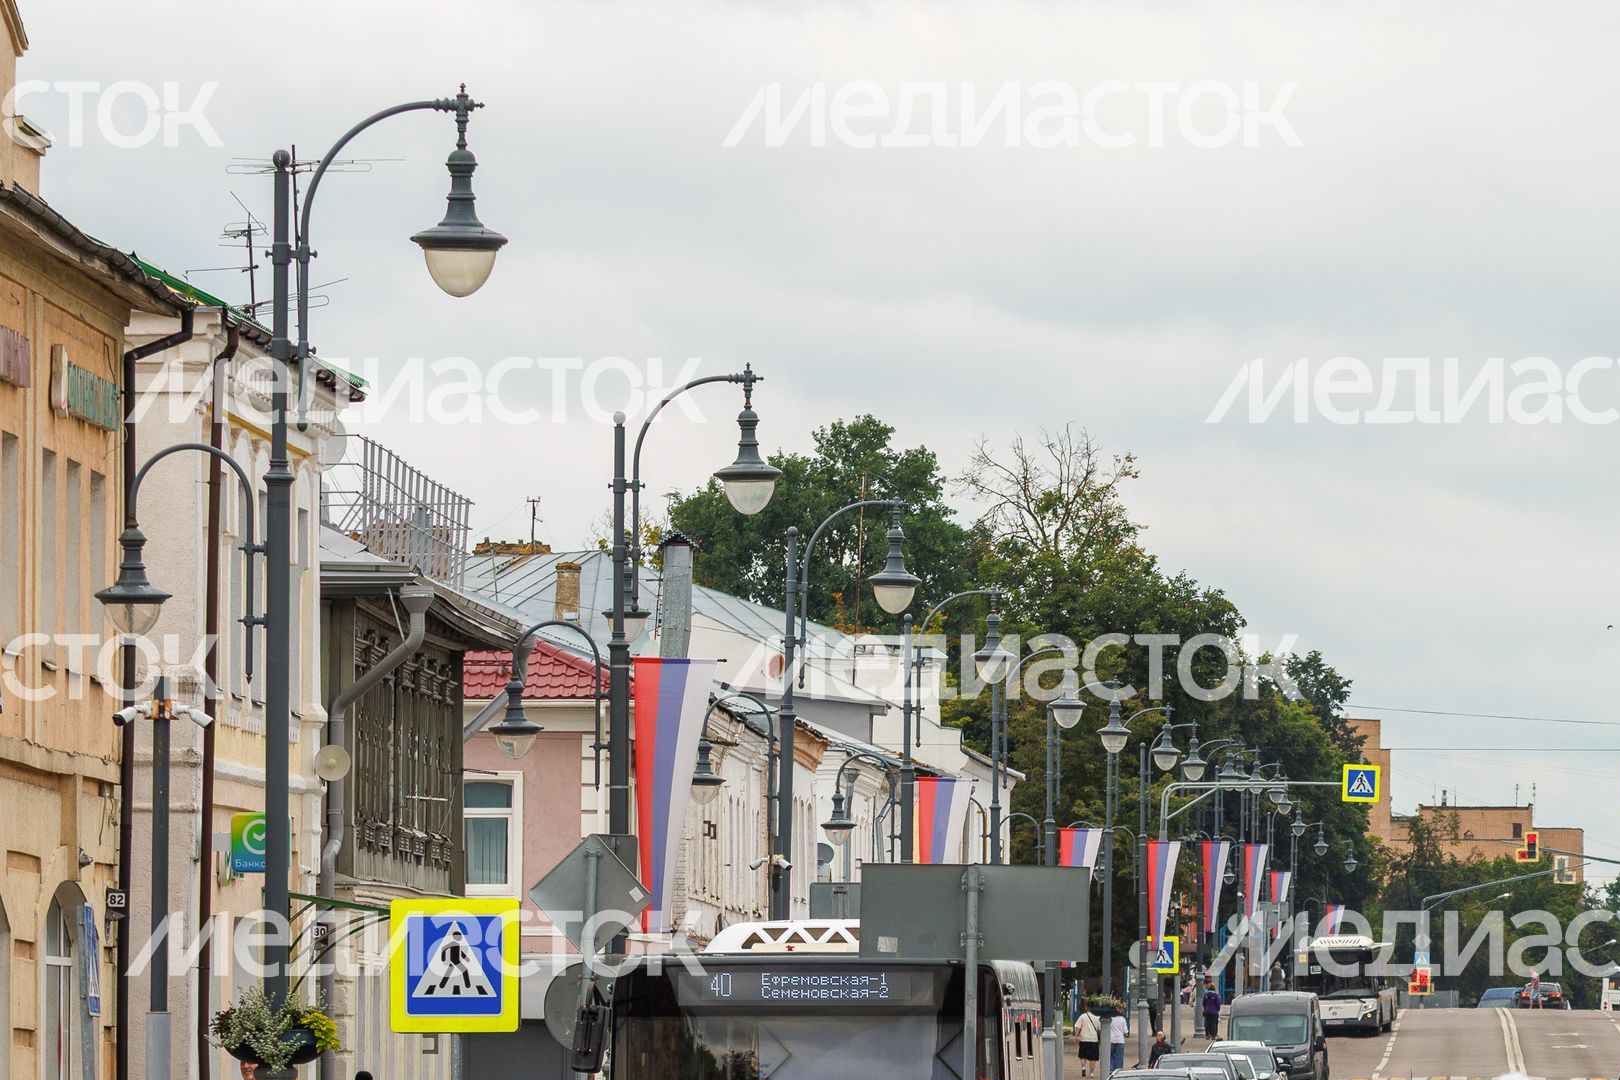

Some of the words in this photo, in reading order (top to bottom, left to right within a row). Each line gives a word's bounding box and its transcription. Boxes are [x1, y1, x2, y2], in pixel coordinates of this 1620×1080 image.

[109, 895, 124, 905] 82
[314, 927, 326, 937] 80
[710, 972, 732, 997] 40
[761, 972, 887, 987] Ефремовская-1
[761, 985, 889, 999] Семеновская-2
